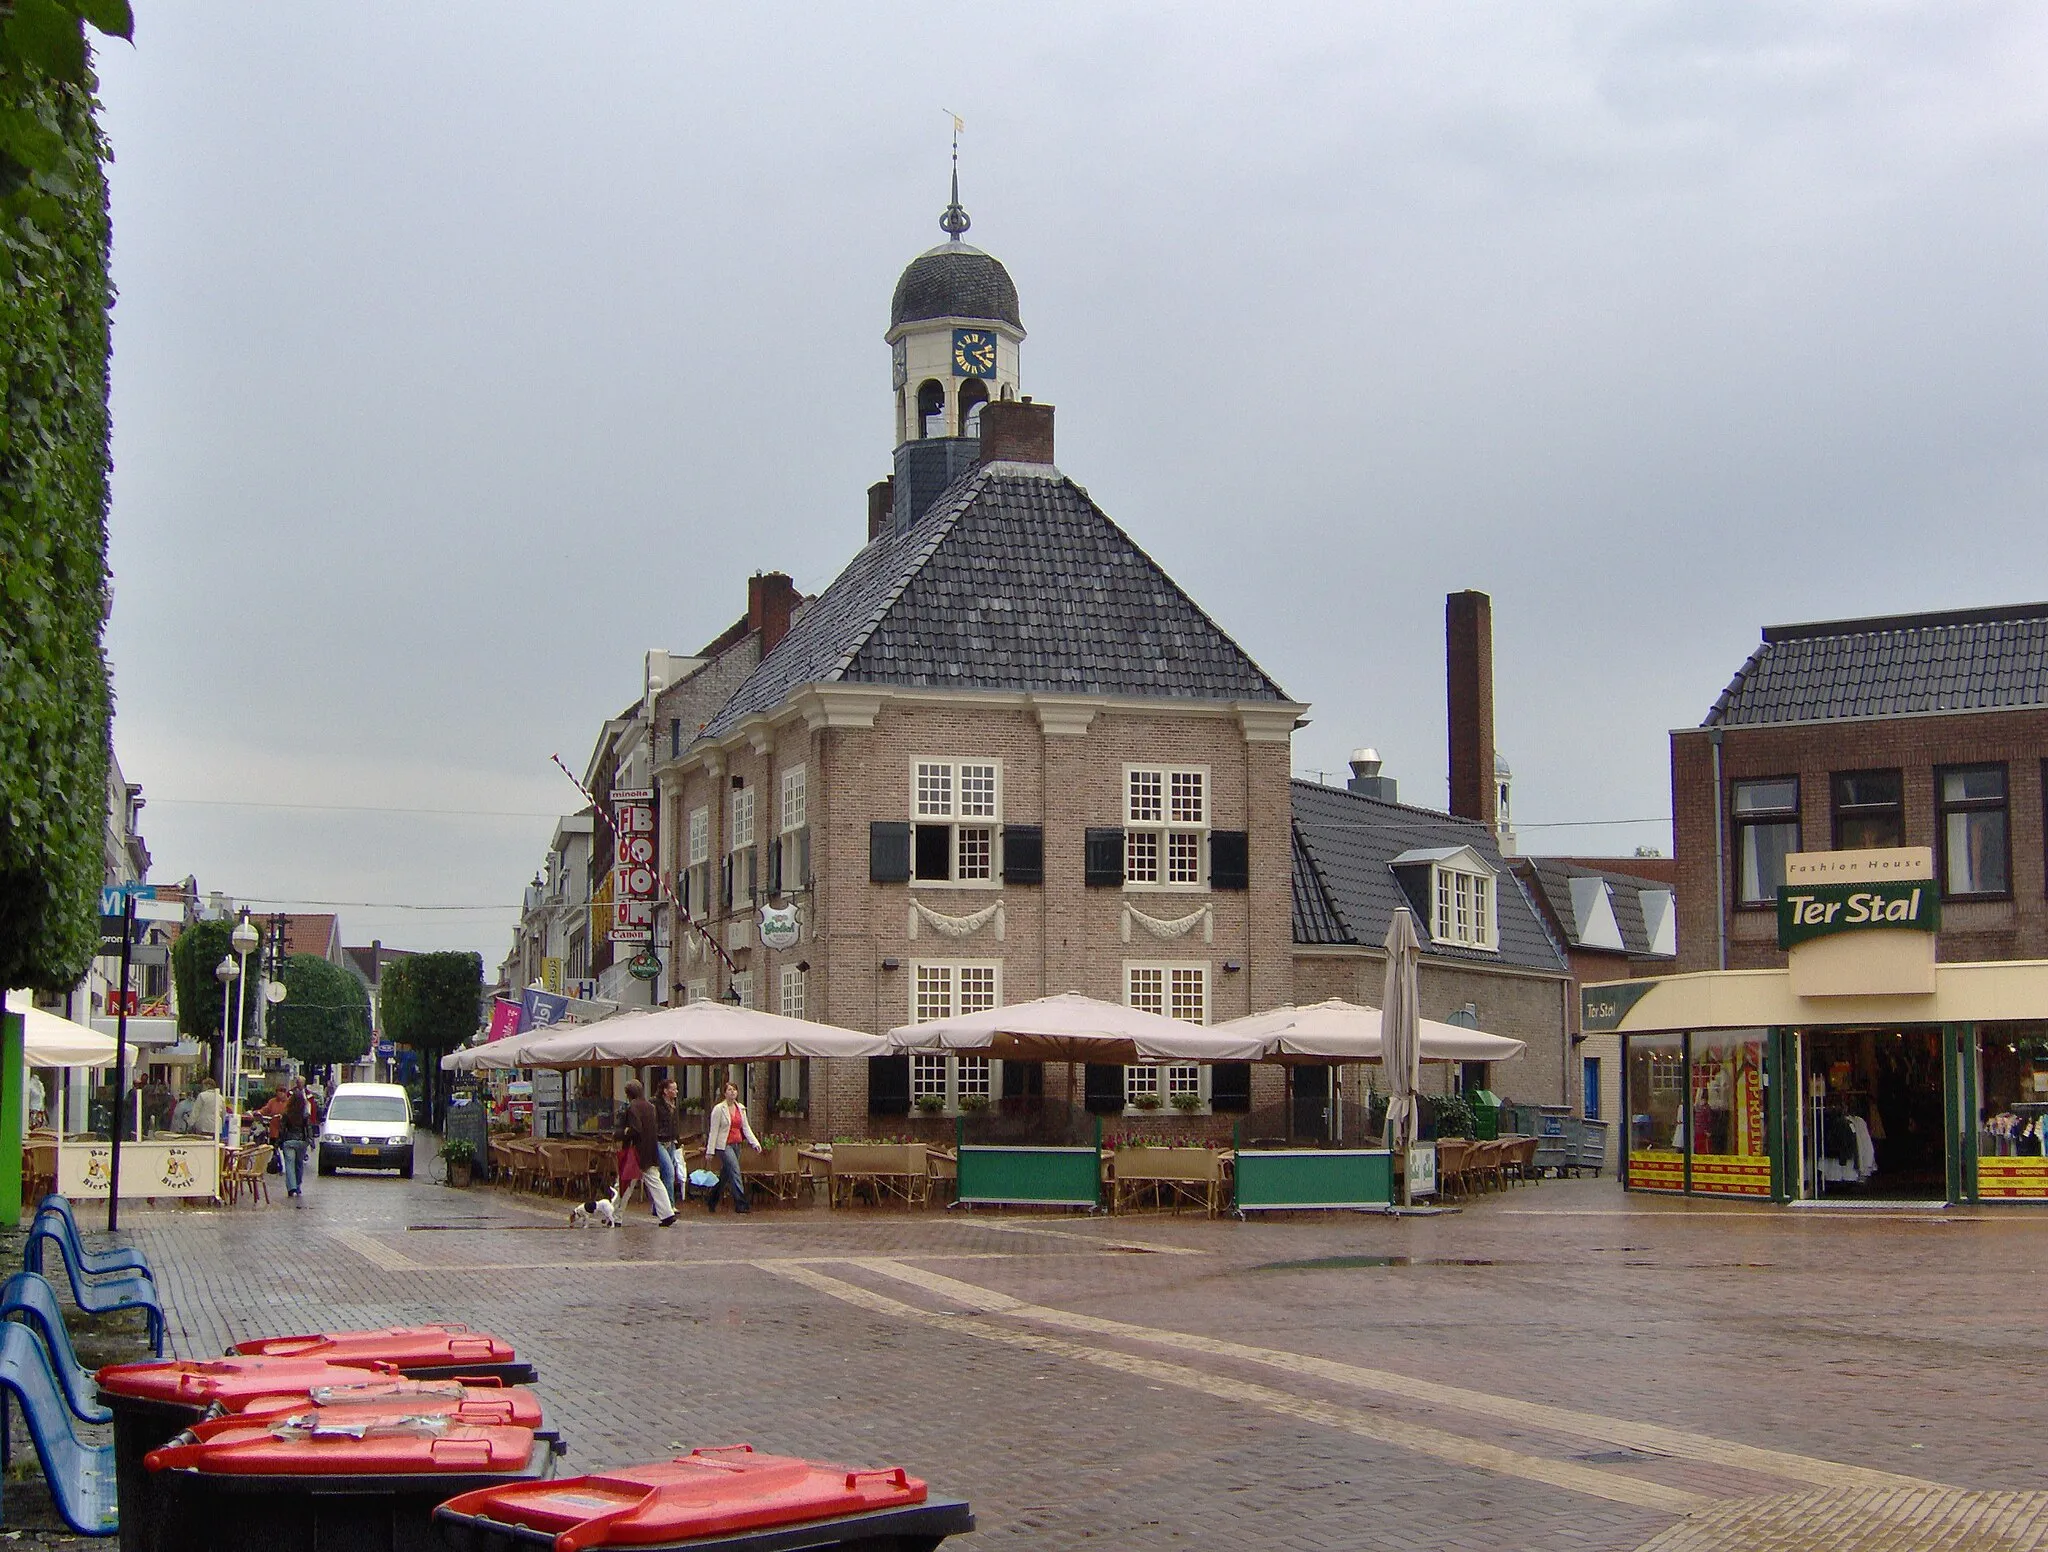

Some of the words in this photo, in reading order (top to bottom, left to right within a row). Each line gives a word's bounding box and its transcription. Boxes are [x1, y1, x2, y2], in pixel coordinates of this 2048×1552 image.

[612, 790, 648, 798] minolta
[1789, 862, 1857, 873] Fashion
[1868, 859, 1921, 869] House
[1787, 895, 1841, 925] Ter
[1844, 888, 1921, 923] Stal
[611, 930, 644, 939] Canon
[1587, 1003, 1599, 1018] Ter
[1600, 1001, 1616, 1018] Stal
[90, 1149, 109, 1157] Bar
[169, 1148, 188, 1156] Bar
[161, 1176, 195, 1189] Biertje
